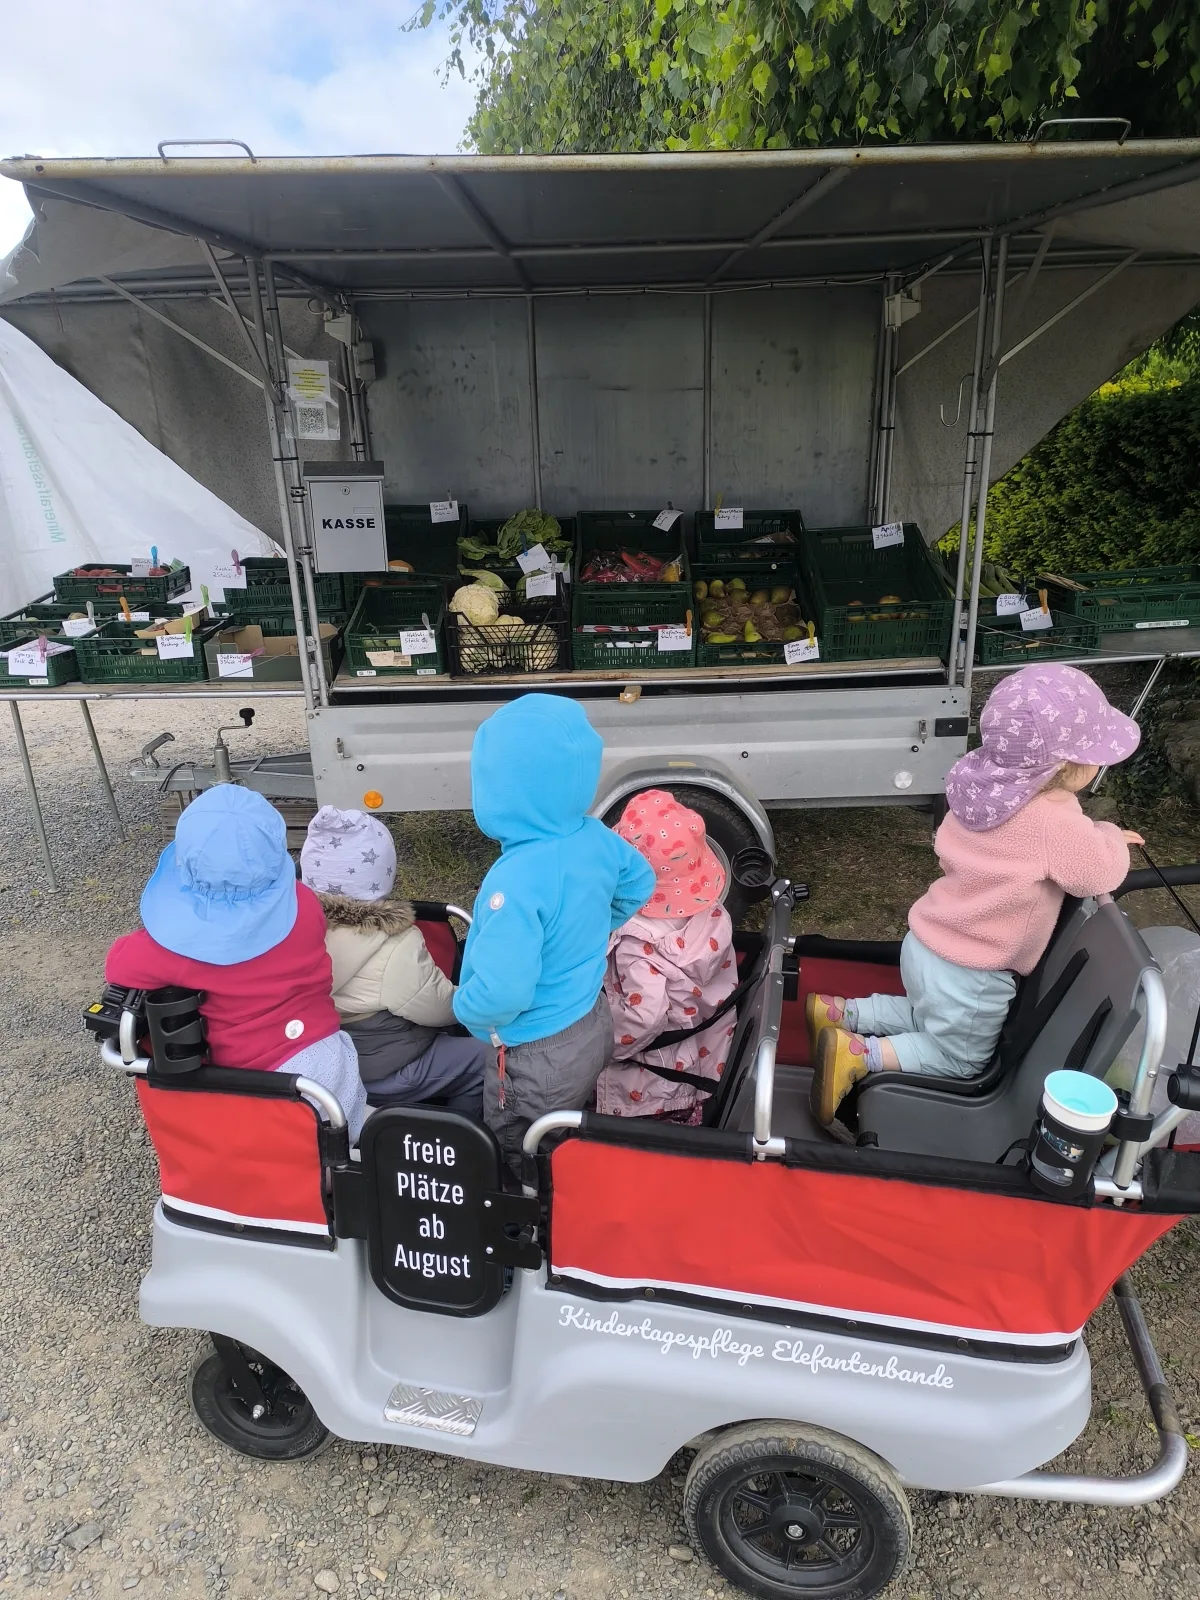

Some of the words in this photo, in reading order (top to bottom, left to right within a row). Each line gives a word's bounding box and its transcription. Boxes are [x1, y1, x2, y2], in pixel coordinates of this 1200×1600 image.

[322, 518, 376, 530] KASSE
[404, 1134, 456, 1166] freie
[397, 1172, 464, 1205] Plätze
[419, 1213, 445, 1240] ab
[394, 1243, 471, 1278] August
[558, 1304, 765, 1366] Kindertagespflege
[771, 1339, 955, 1389] Elefantenbande
